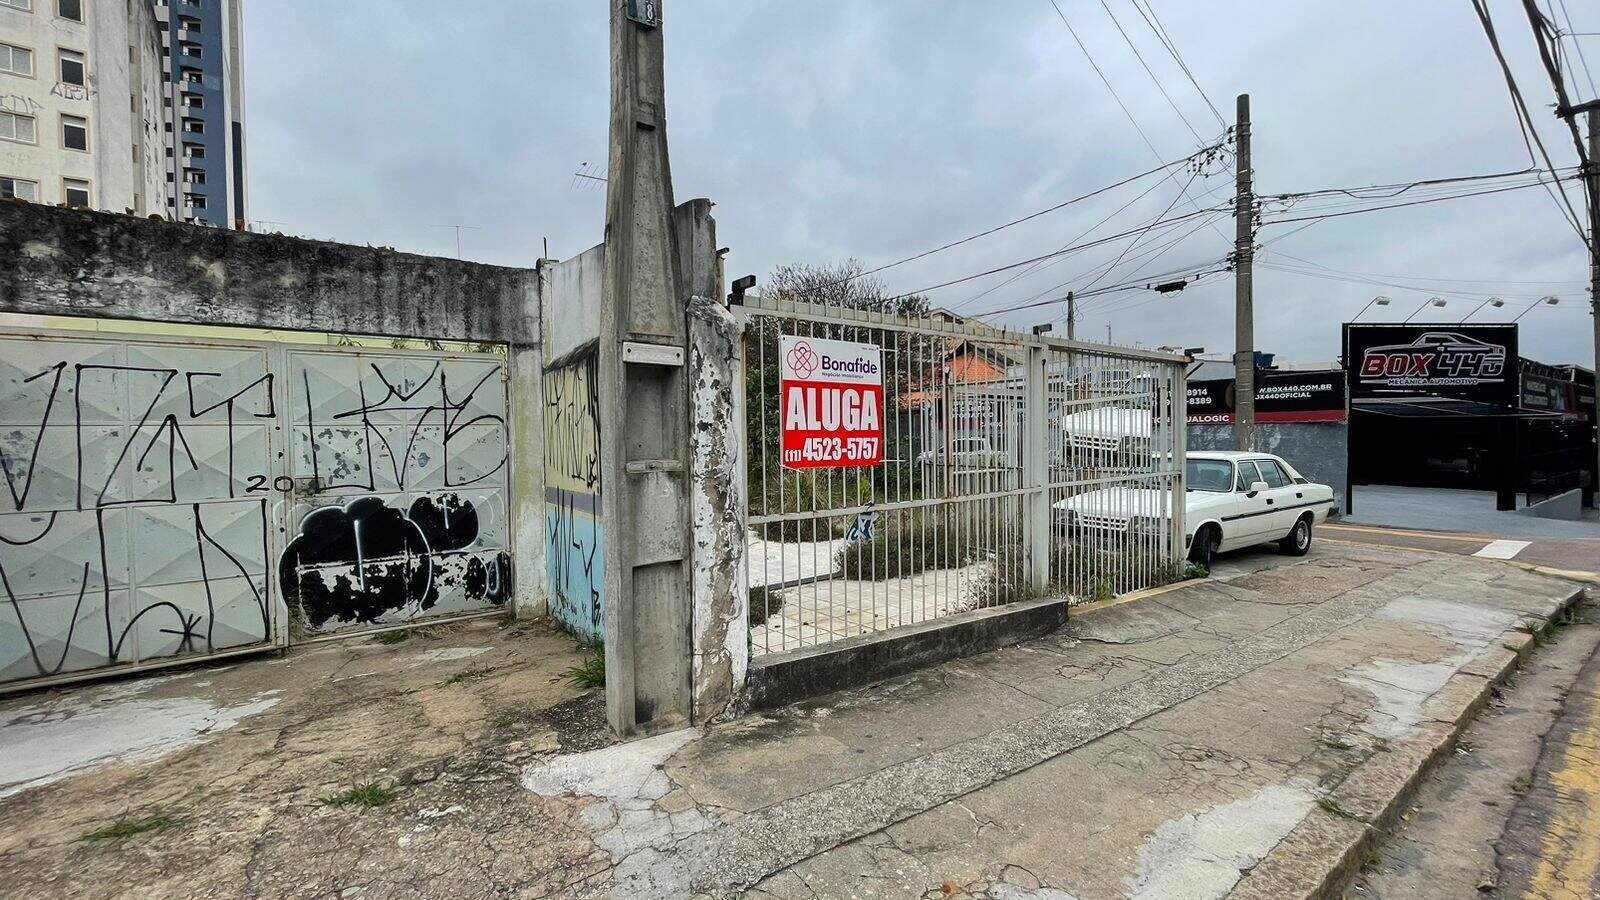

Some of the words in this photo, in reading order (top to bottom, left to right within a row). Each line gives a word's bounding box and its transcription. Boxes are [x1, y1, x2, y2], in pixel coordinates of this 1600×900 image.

[821, 355, 878, 375] Bonafide
[1359, 353, 1436, 377] BOX
[1437, 353, 1505, 377] 440
[1387, 376, 1428, 386] MECÂNICA
[1429, 377, 1480, 386] AUTOMOTIVO
[785, 386, 879, 432] ALUGA
[784, 449, 802, 462] (11)
[802, 437, 879, 461] 4523-5757
[245, 475, 294, 493] 20
